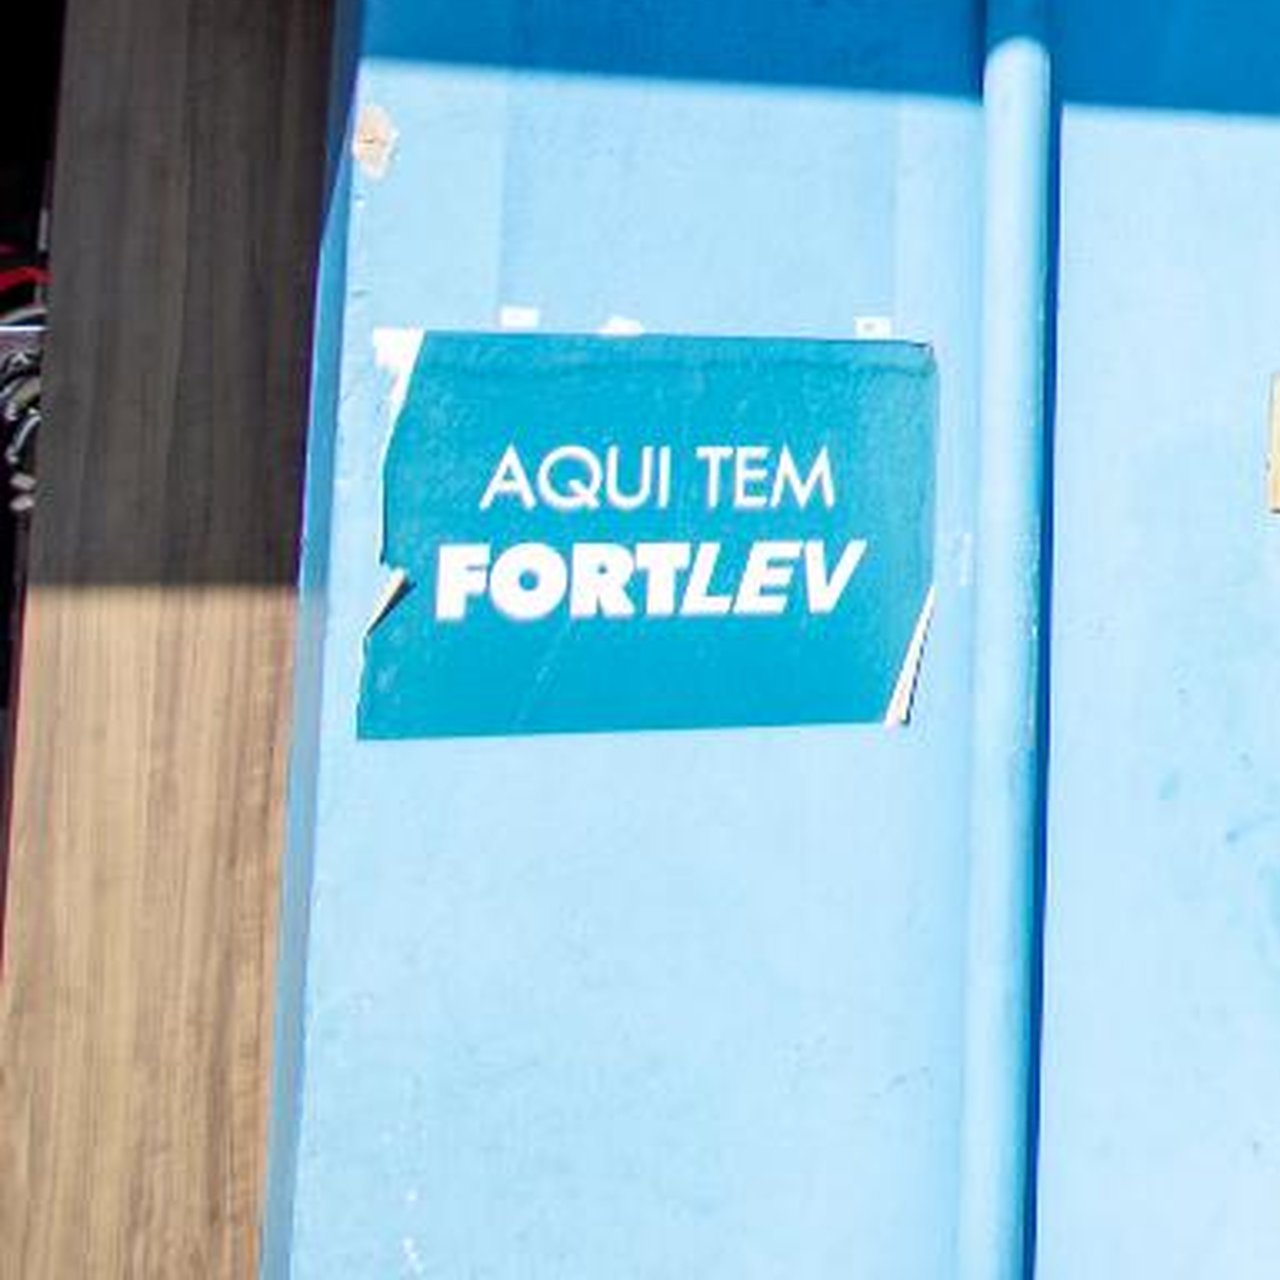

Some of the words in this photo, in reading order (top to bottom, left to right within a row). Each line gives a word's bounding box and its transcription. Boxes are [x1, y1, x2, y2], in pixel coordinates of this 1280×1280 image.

[480, 443, 671, 510] AQUI
[696, 444, 836, 508] TEM
[435, 538, 867, 620] FORTLEV
